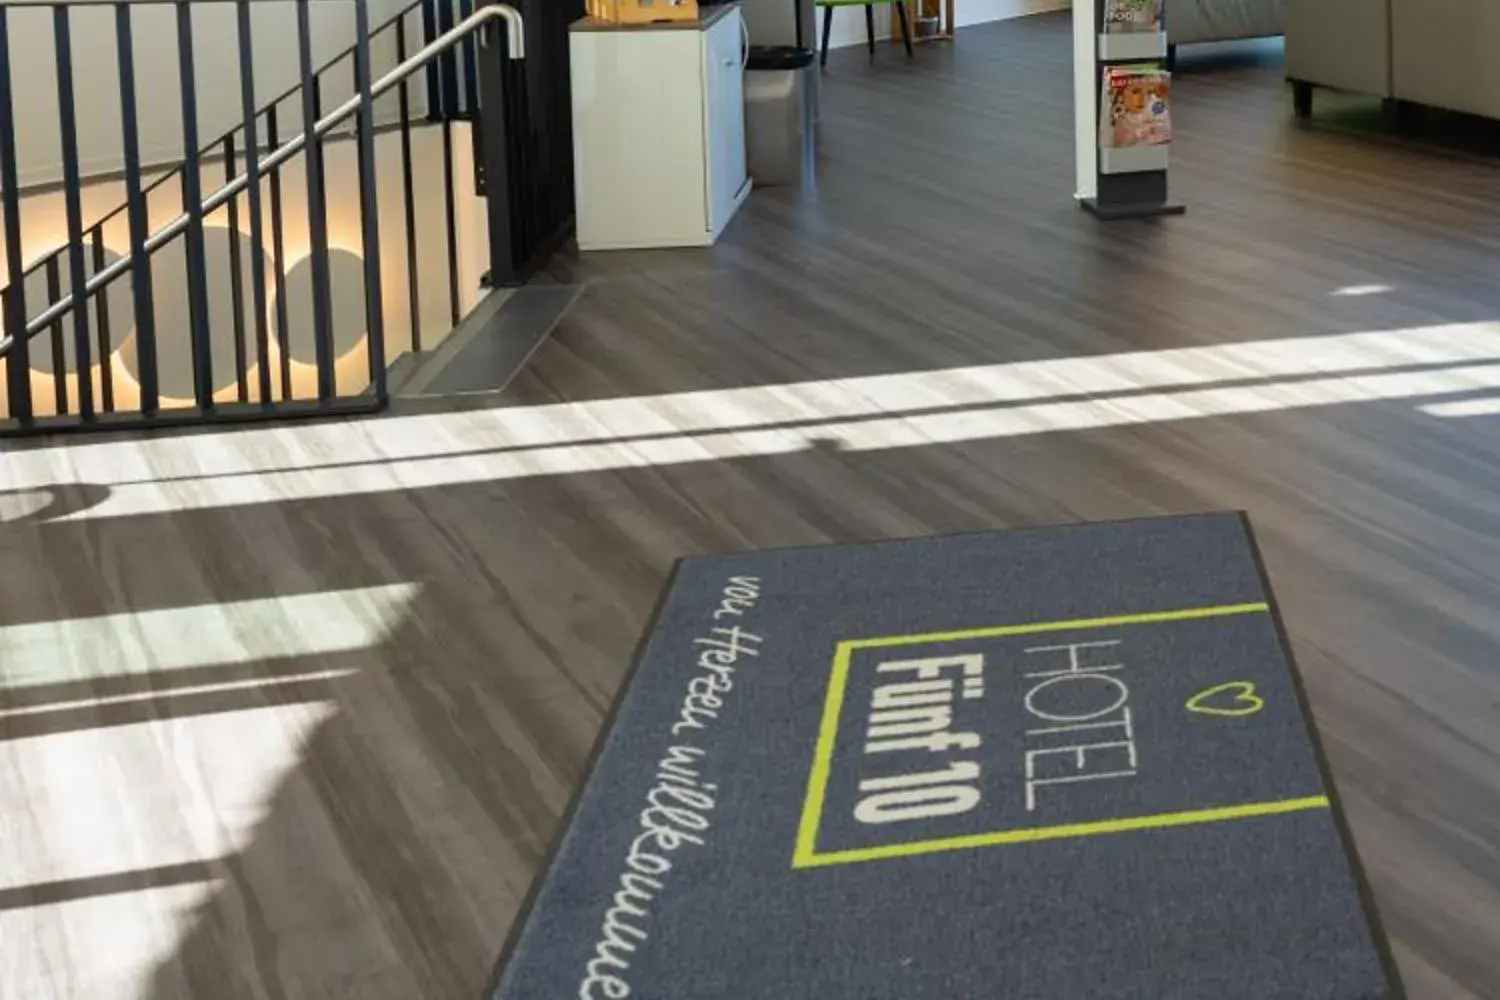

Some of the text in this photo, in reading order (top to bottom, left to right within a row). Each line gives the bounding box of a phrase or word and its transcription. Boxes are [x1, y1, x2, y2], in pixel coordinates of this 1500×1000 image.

[578, 574, 764, 1000] von Herzen willkomme
[853, 652, 985, 824] Fünf 10
[1023, 638, 1138, 812] HOTEL
